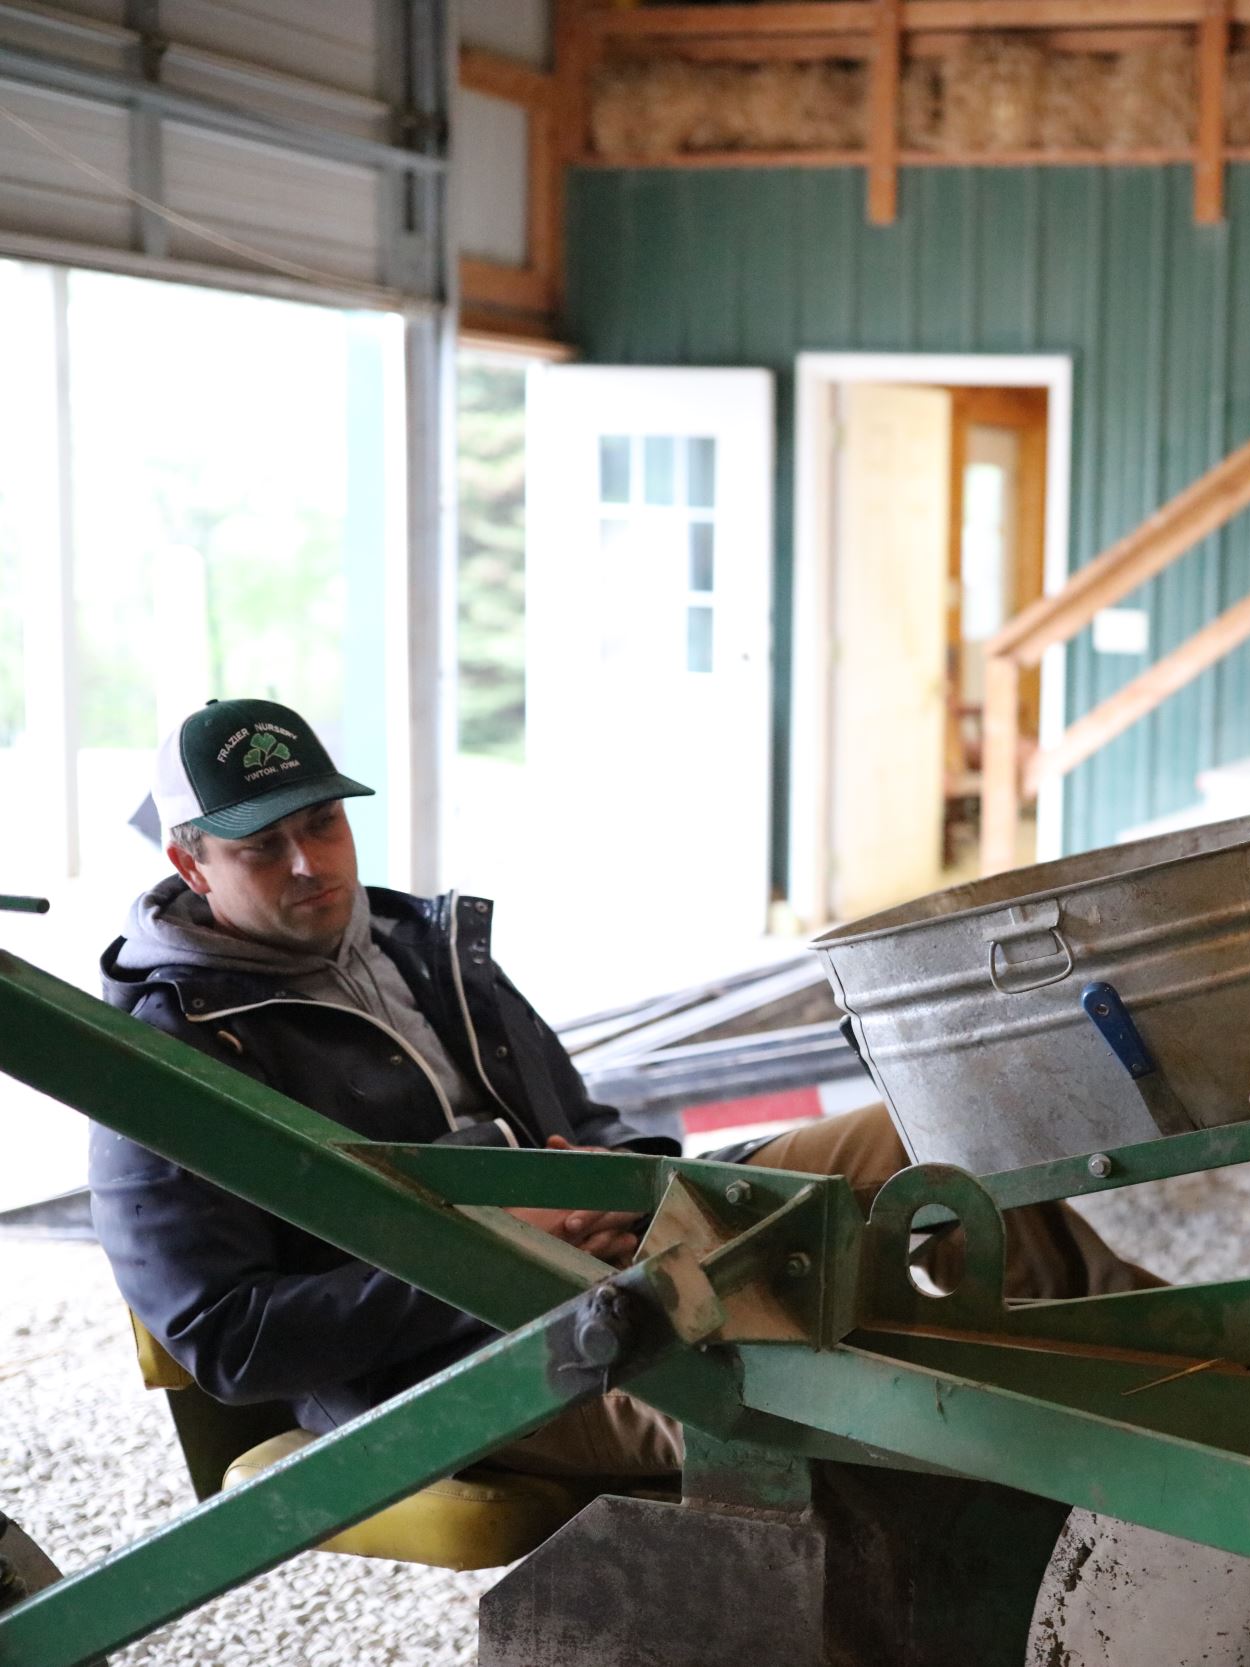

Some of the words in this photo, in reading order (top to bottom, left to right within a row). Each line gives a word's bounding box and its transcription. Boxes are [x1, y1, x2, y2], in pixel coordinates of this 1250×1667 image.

[216, 728, 250, 763] FRAZIER
[254, 722, 297, 740] NURSERY
[280, 759, 300, 770] IOWA
